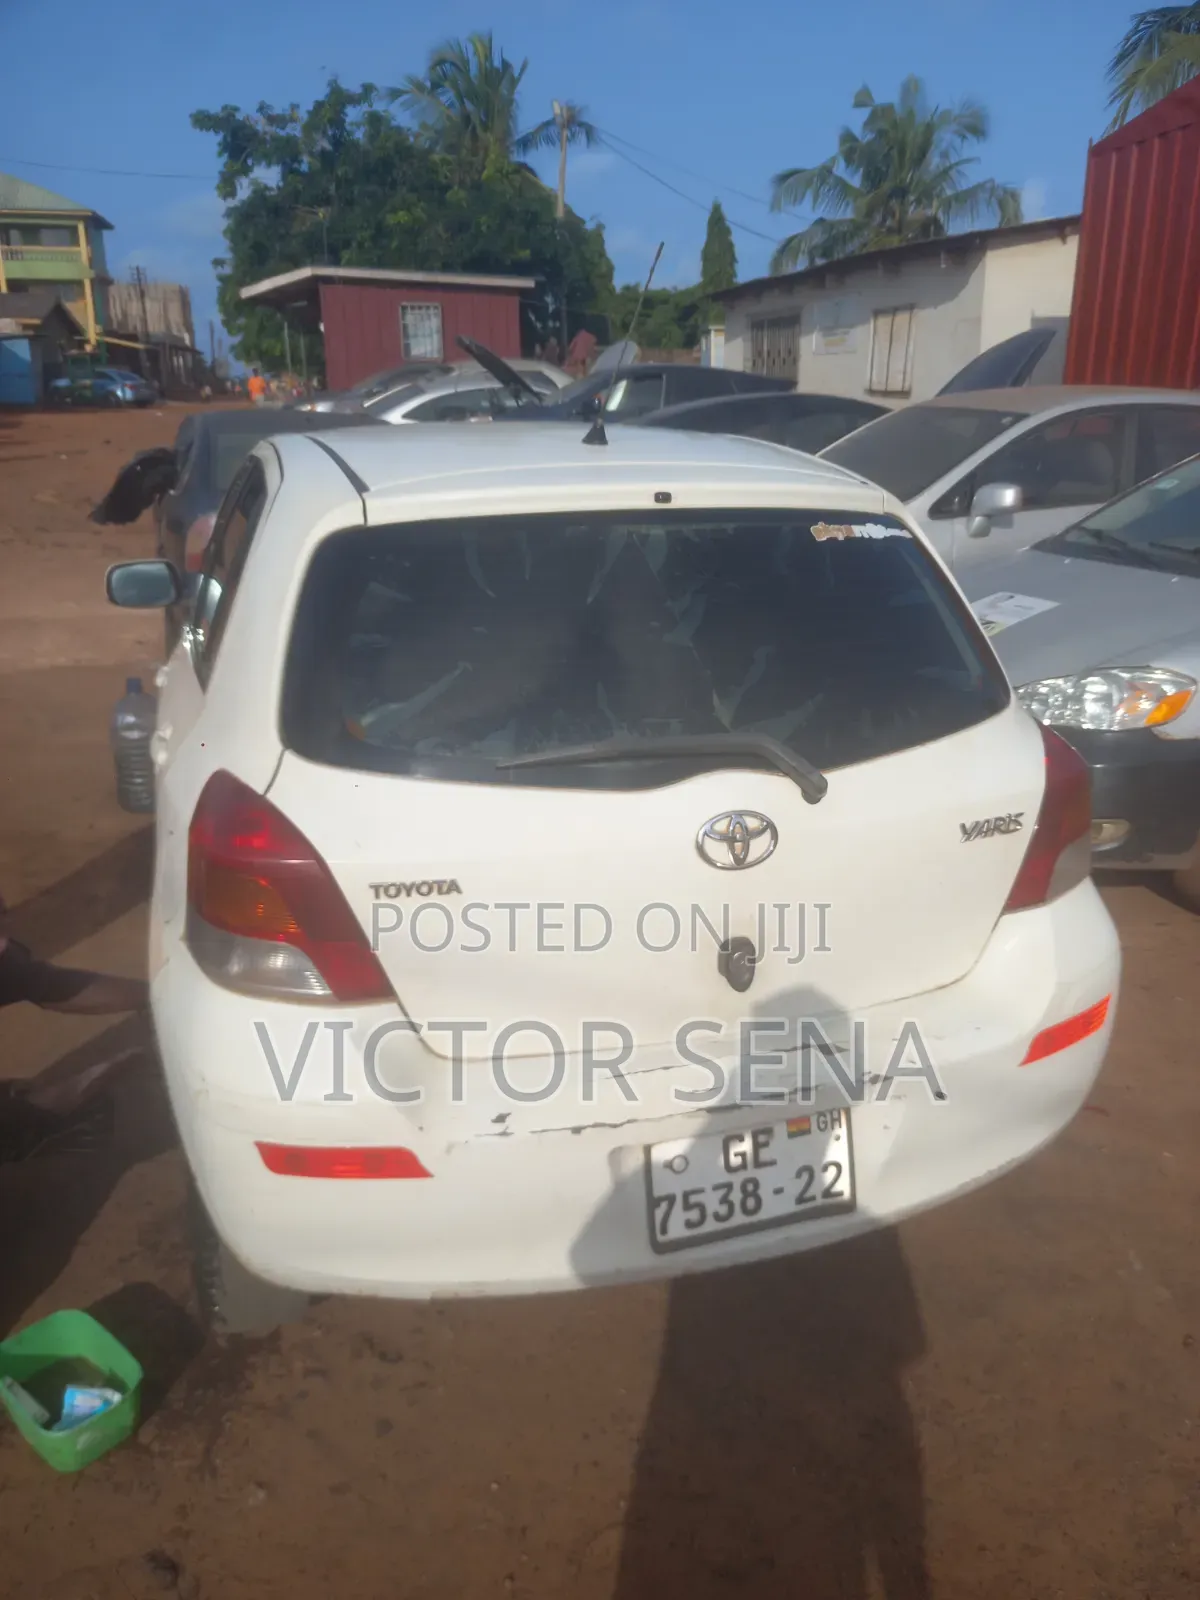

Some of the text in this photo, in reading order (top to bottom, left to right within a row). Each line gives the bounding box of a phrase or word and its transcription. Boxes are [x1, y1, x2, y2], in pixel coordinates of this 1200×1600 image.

[959, 812, 1025, 843] YARIS
[369, 878, 463, 900] TOYOTA
[815, 1109, 843, 1132] GH
[721, 1126, 778, 1174] GE
